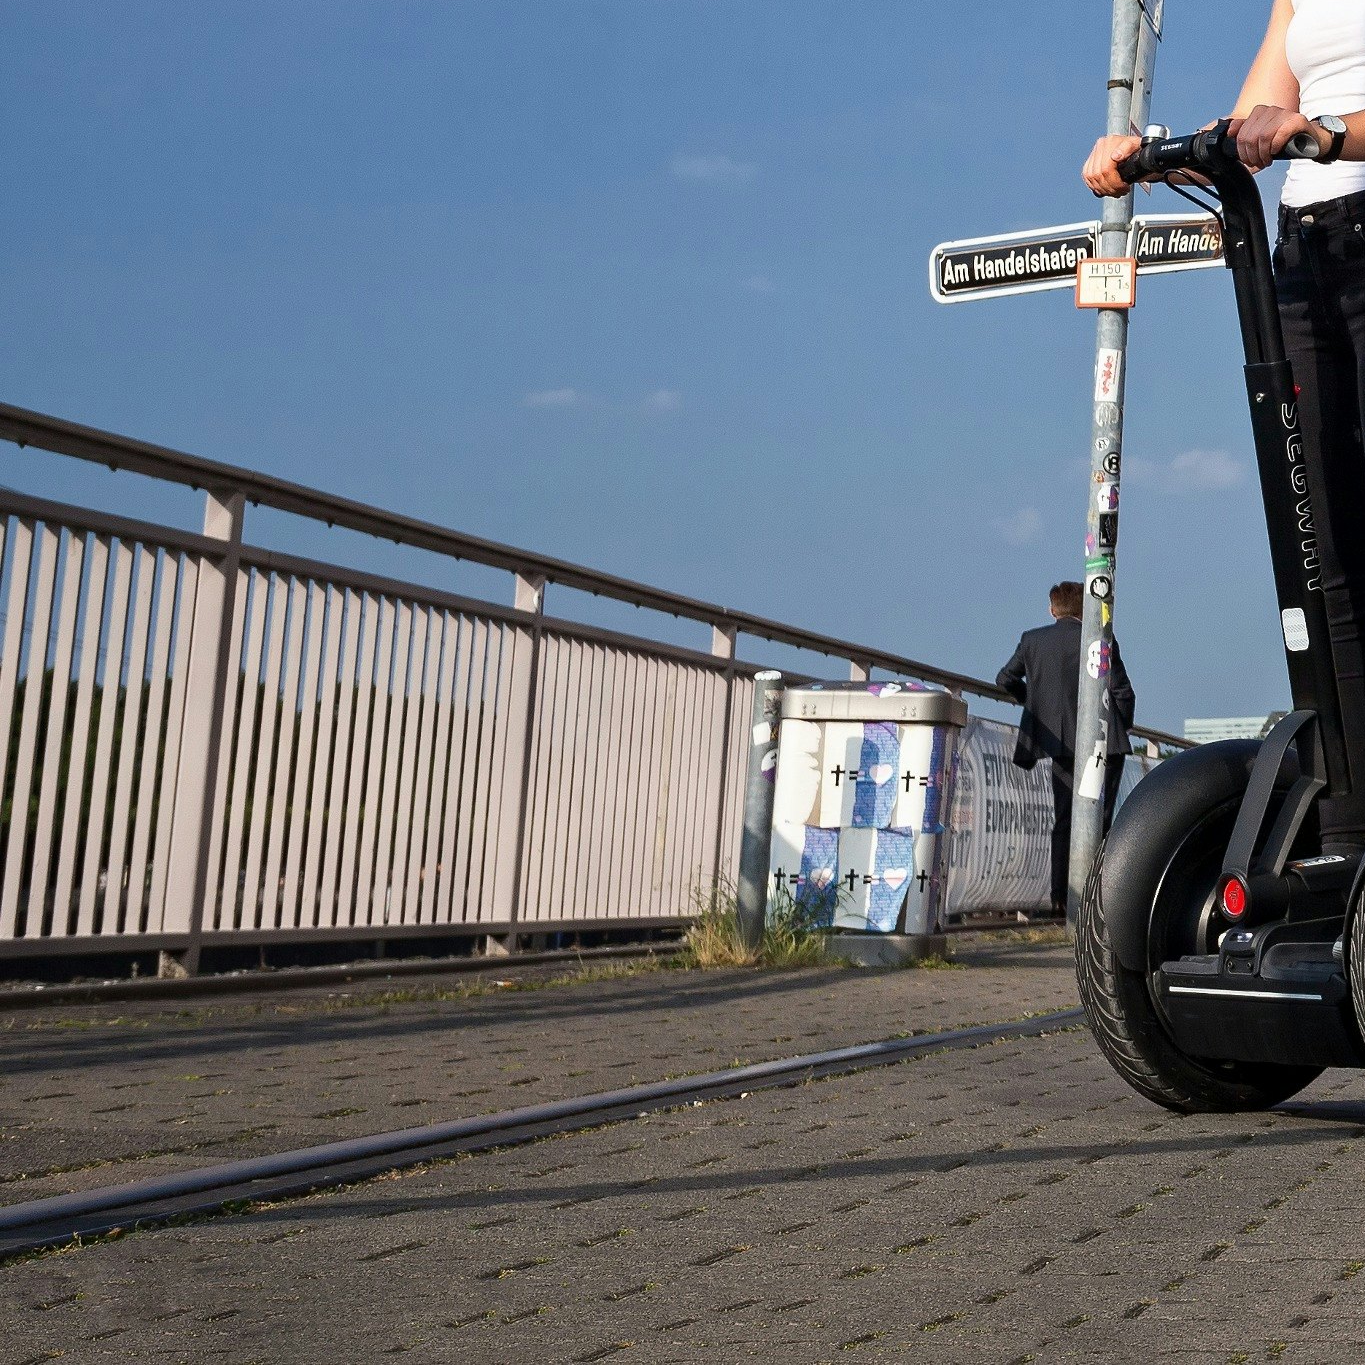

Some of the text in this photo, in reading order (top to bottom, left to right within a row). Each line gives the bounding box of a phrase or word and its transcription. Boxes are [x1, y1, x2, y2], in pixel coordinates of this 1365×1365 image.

[1138, 231, 1164, 256] Am
[943, 242, 1088, 285] Am Handelshafen
